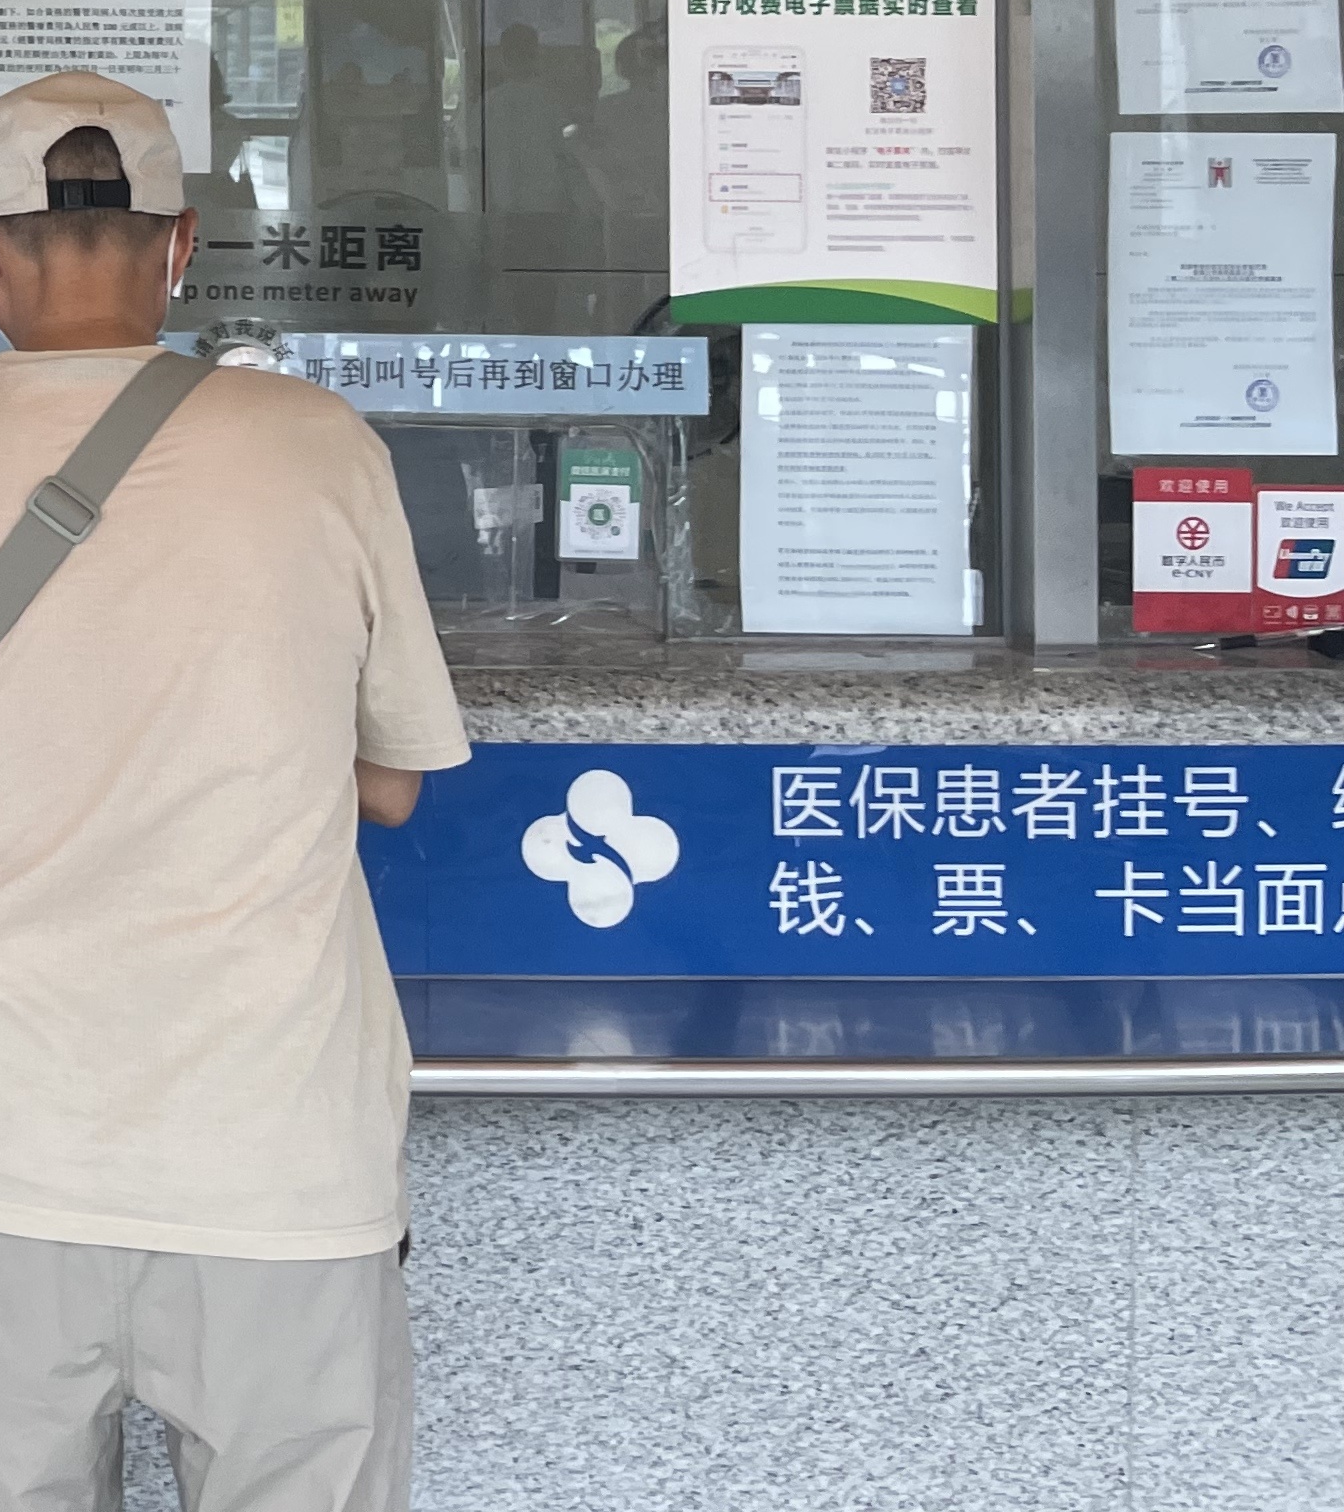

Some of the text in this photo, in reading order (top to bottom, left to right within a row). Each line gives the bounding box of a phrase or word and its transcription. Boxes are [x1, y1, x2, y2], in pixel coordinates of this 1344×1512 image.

[192, 223, 424, 272] 一米距离
[206, 284, 255, 301] one
[262, 282, 344, 302] meter
[349, 286, 419, 308] away
[305, 356, 686, 393] 听到叫号后再到窗口办理
[769, 763, 1344, 841] 医保患者挂号、
[767, 860, 1344, 938] 钱、票、卡当面
